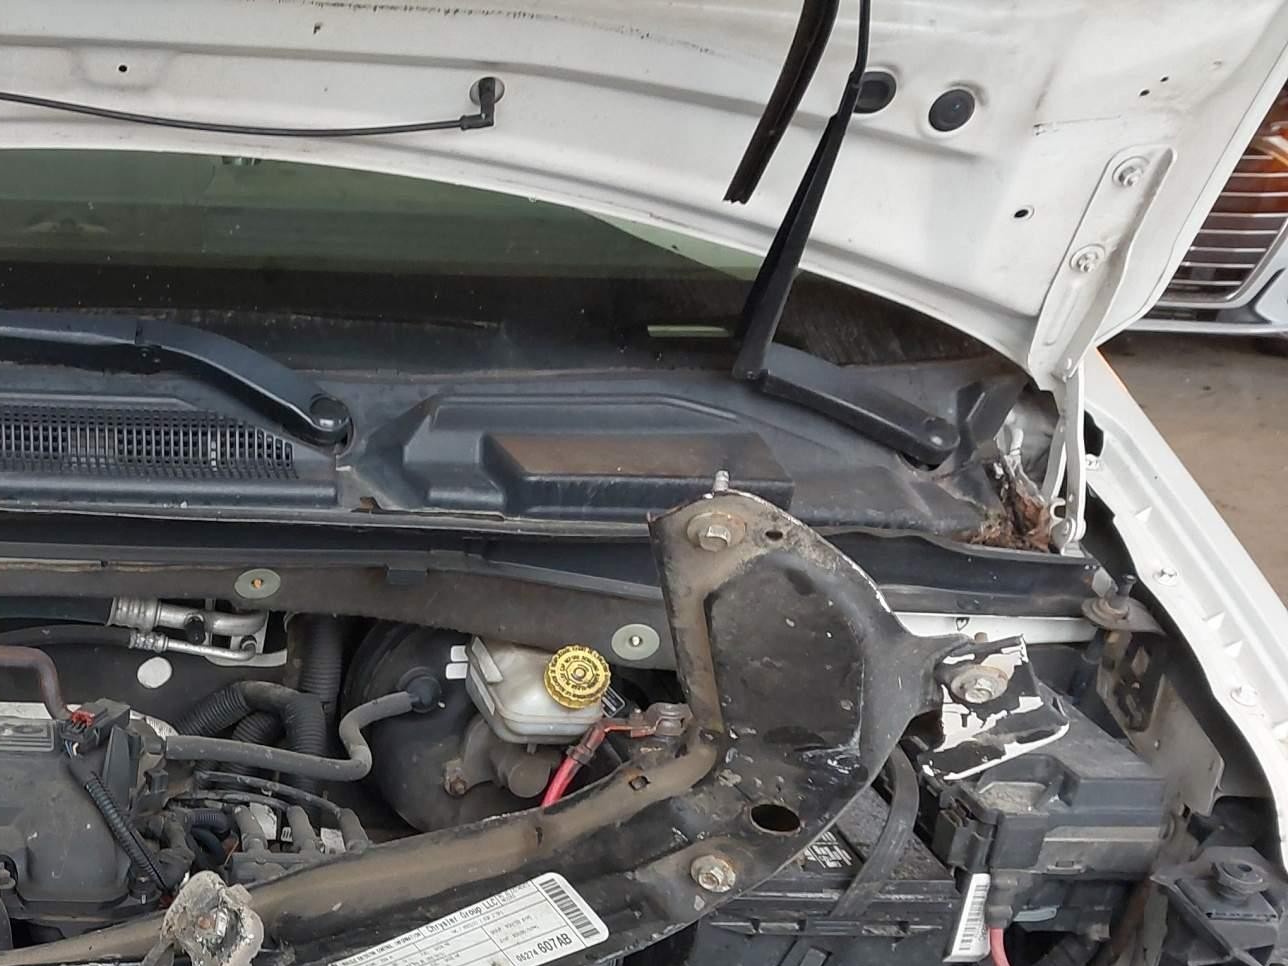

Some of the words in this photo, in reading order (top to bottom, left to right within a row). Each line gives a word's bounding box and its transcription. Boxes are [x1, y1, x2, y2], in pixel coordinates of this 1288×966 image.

[425, 916, 458, 933] Chrysler
[459, 906, 482, 919] Group
[482, 898, 499, 910] LLC
[537, 933, 573, 954] 607AB
